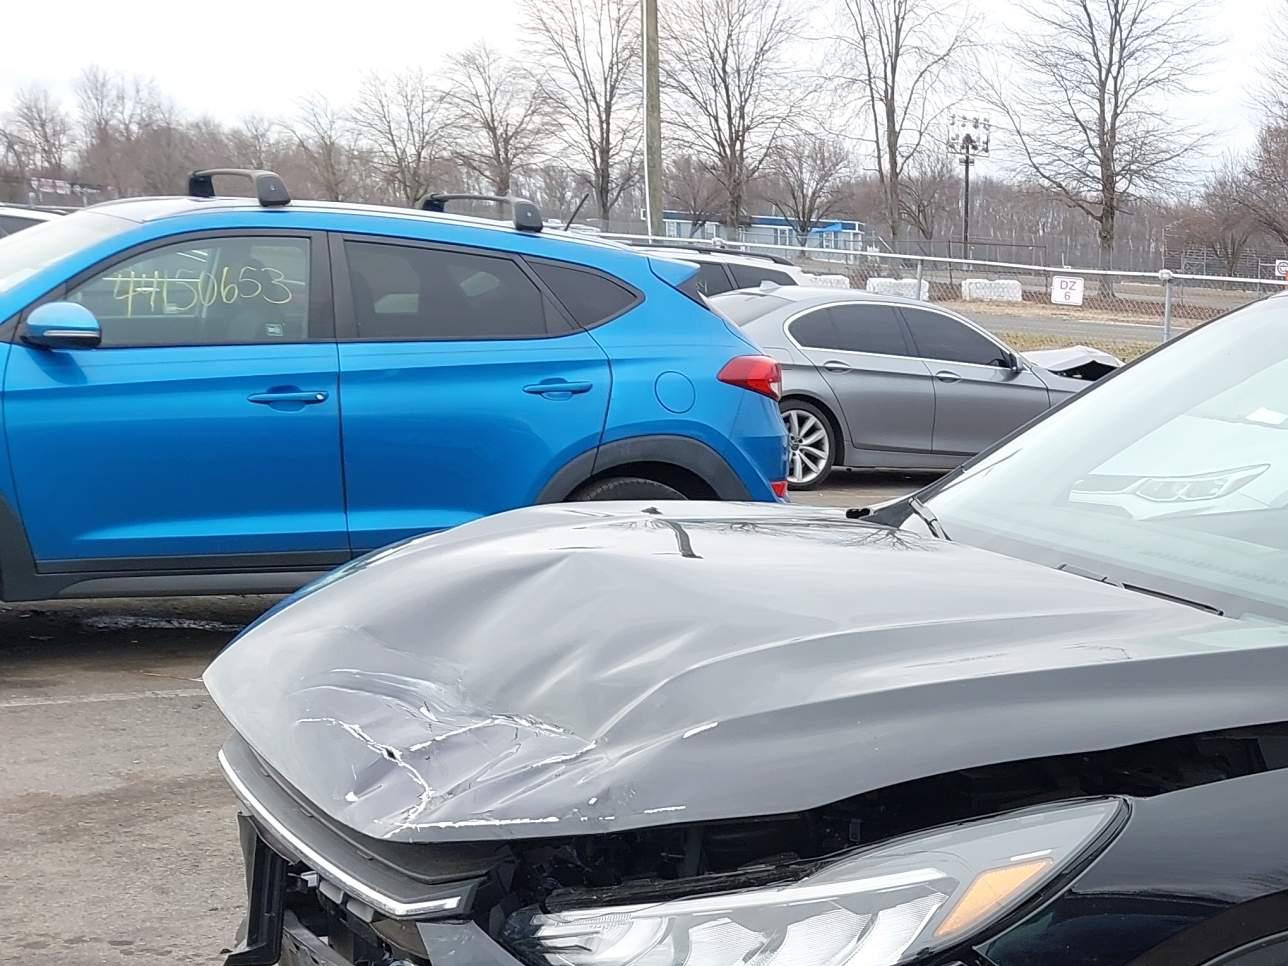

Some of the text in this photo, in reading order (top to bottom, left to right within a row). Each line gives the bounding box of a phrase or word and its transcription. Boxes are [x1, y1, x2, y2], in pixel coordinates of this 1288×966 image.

[1060, 279, 1077, 291] DZ
[113, 266, 293, 318] 44150653
[1064, 291, 1071, 301] 6
